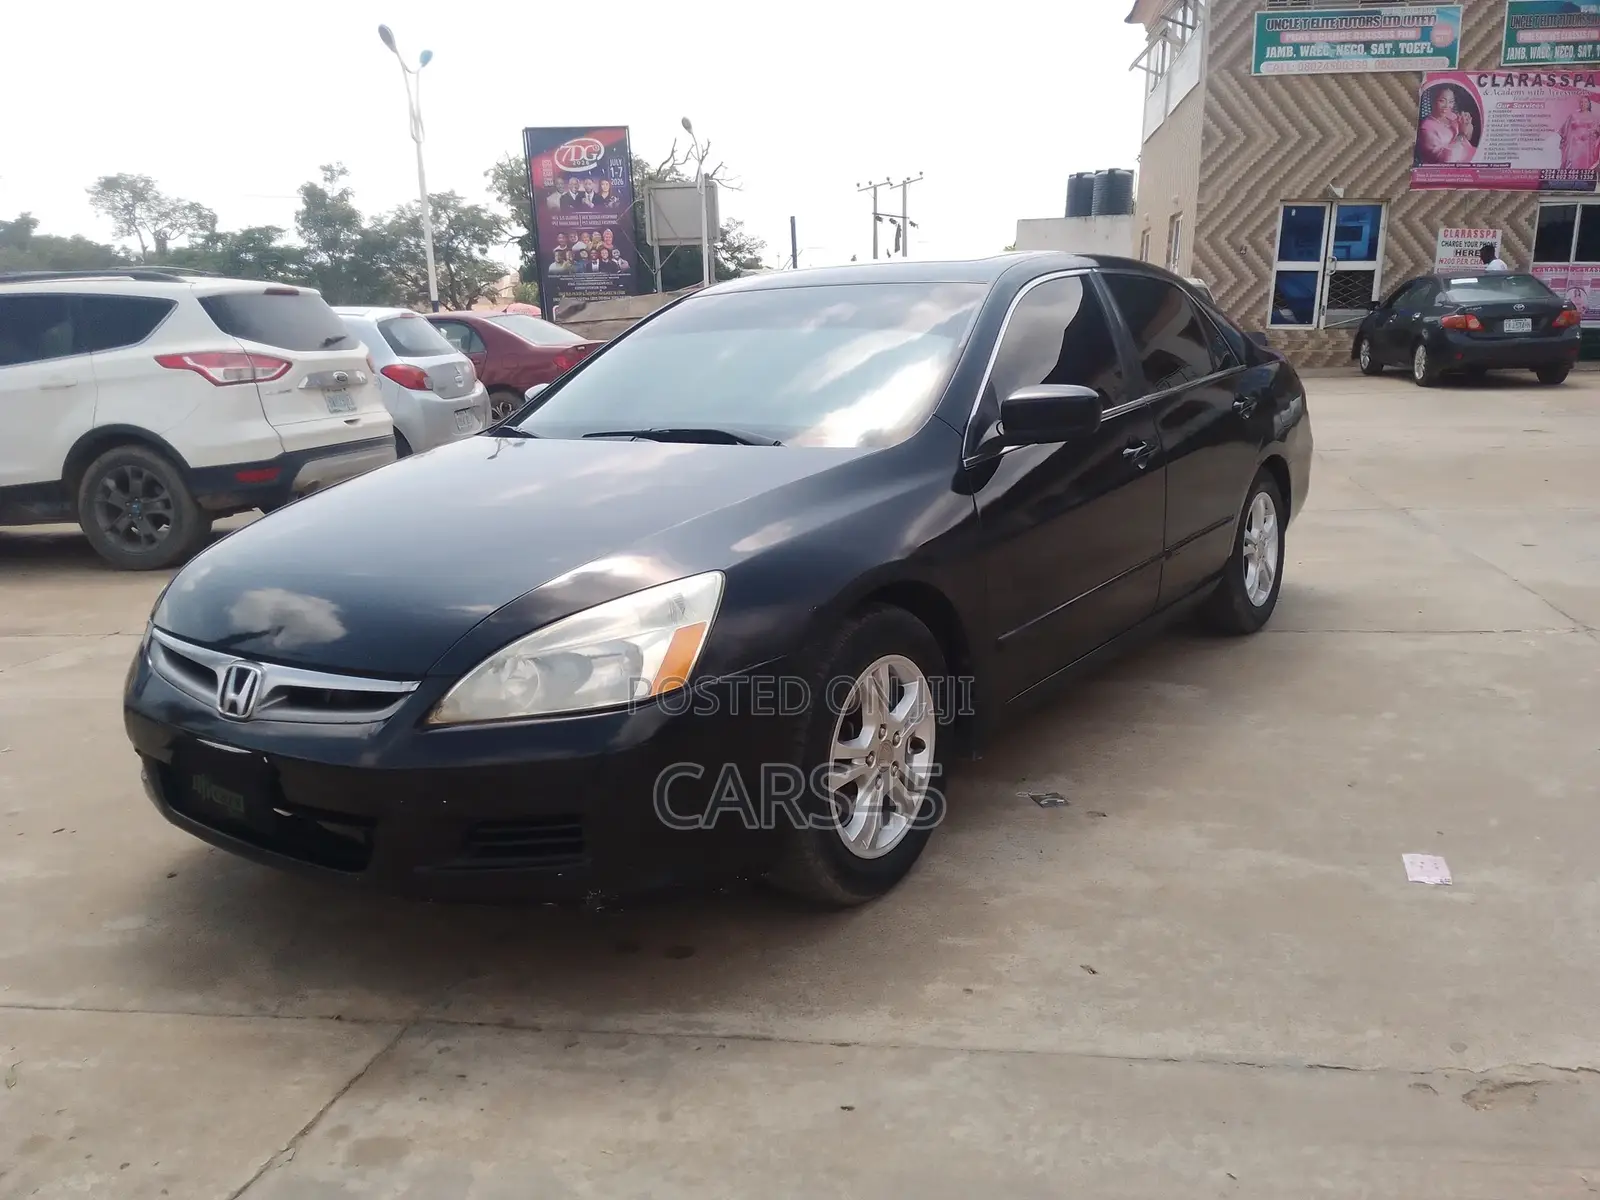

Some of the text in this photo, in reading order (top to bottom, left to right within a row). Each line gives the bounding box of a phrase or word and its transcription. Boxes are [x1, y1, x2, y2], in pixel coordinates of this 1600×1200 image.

[1266, 17, 1300, 31] UNCLE
[1310, 16, 1337, 30] ELITE
[1337, 15, 1381, 29] TUTORS
[1381, 15, 1401, 27] LTD
[1399, 41, 1434, 54] TOEFL
[1477, 73, 1596, 88] CLARASSPA
[609, 158, 622, 167] JULY
[609, 167, 623, 178] 1-7
[1443, 229, 1497, 239] CLARASSPA
[1441, 240, 1463, 248] CHARGE
[1464, 240, 1478, 248] YOUR
[1456, 257, 1468, 265] PER
